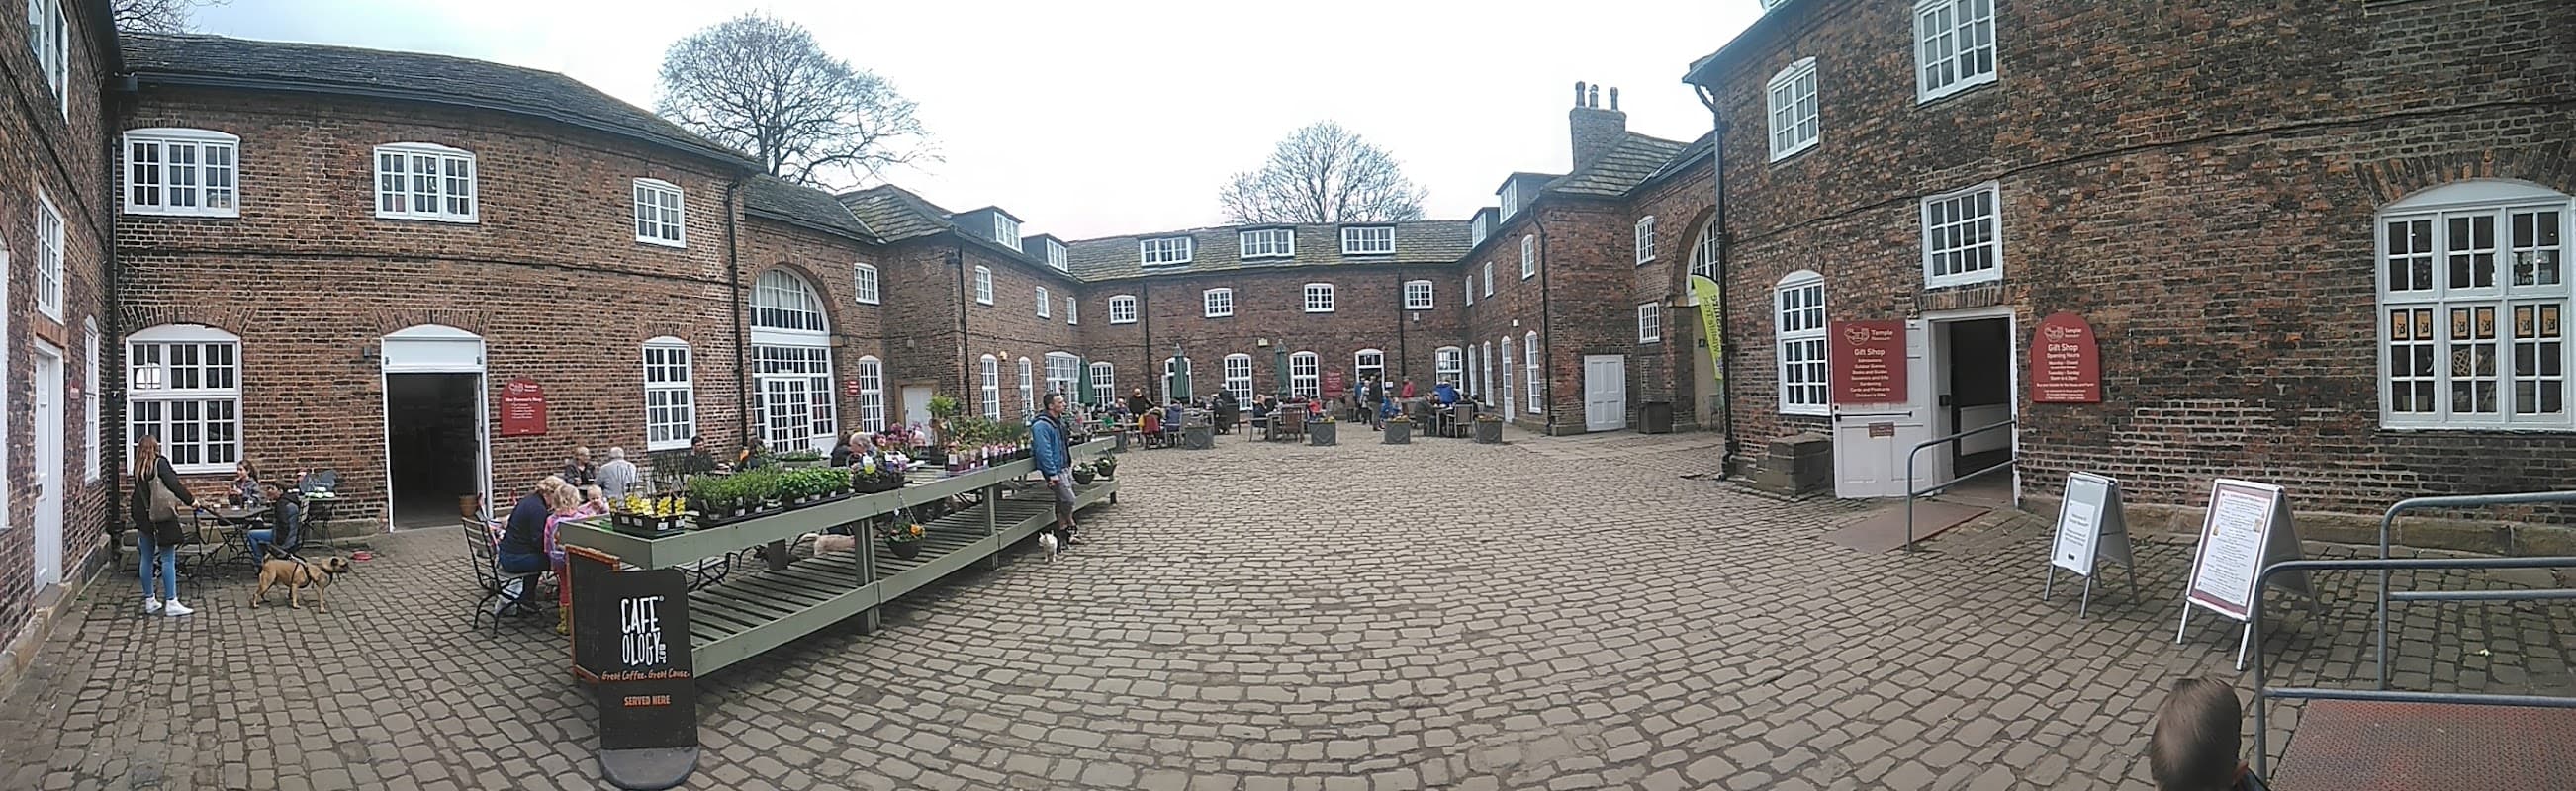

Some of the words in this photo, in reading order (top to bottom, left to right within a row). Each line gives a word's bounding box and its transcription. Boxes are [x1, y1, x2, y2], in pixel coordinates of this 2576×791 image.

[621, 596, 661, 634] CAFE
[622, 632, 661, 666] OLOGY
[602, 671, 620, 680] Great
[622, 670, 647, 681] Coffee.
[648, 669, 667, 680] Great
[668, 668, 690, 678] Cause.
[624, 695, 651, 706] SERVED
[652, 695, 671, 705] HERE
